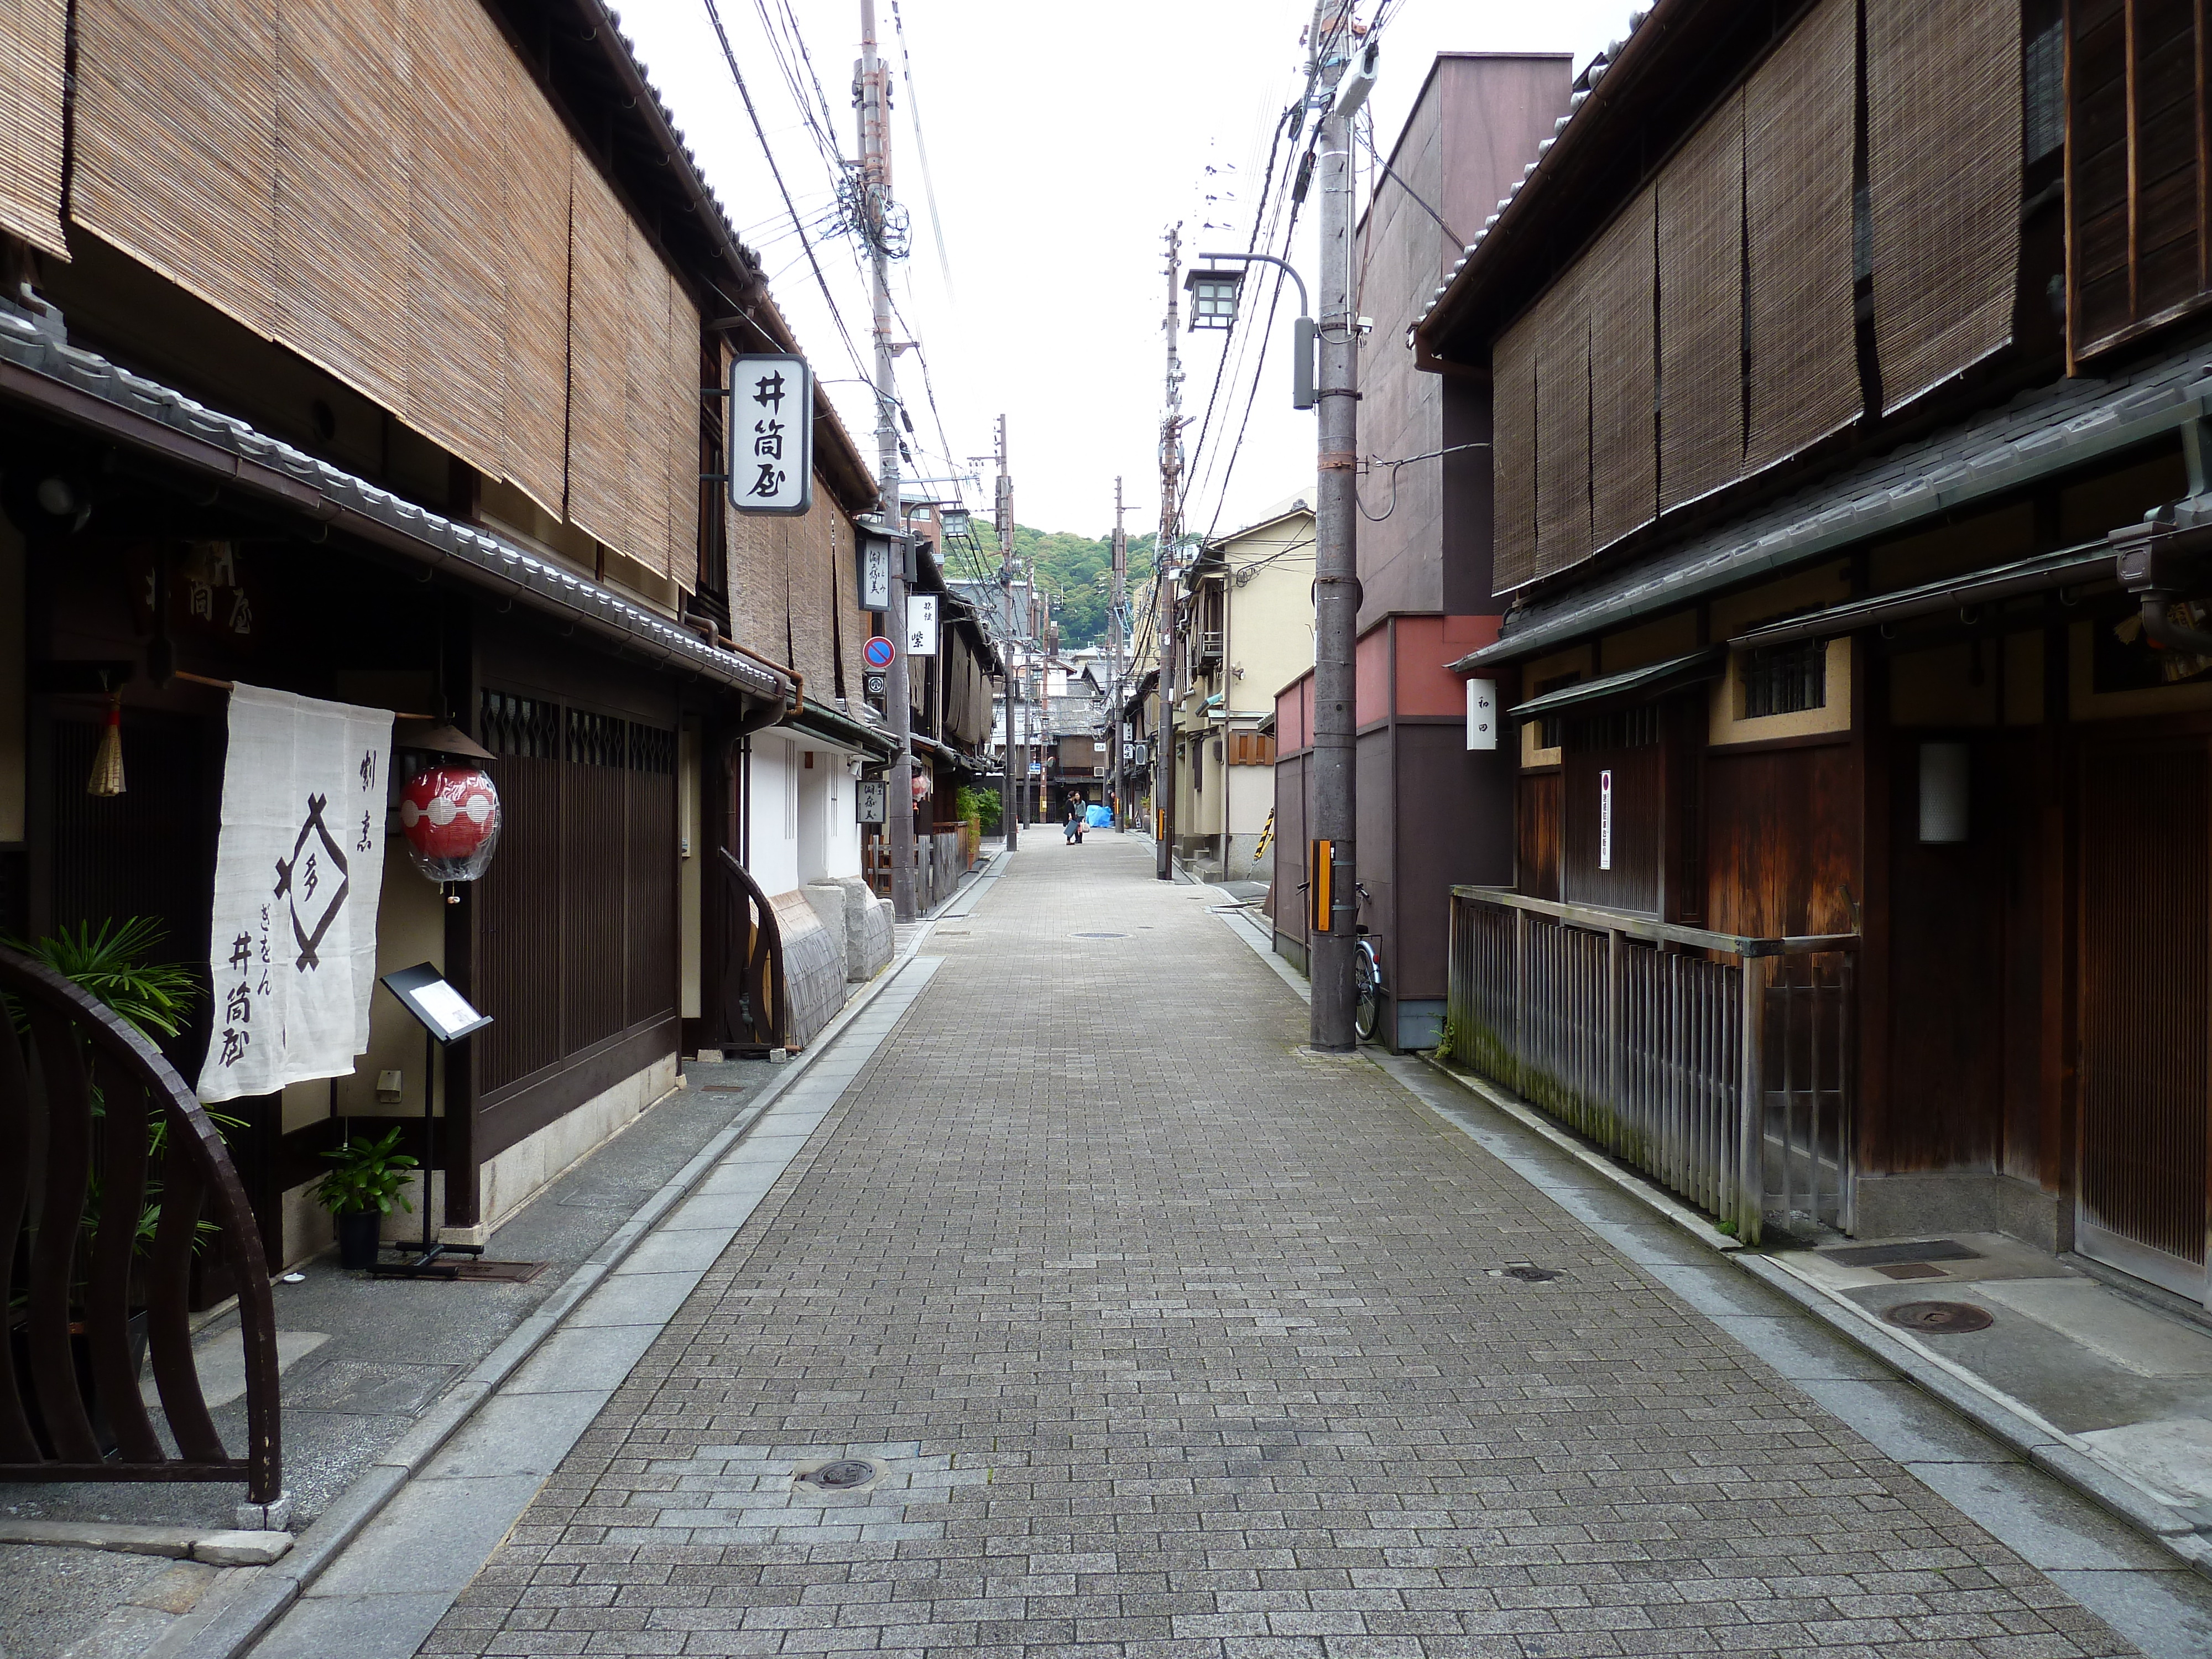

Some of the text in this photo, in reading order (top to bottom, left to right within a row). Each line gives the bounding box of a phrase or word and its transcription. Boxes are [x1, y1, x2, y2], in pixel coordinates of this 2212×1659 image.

[745, 369, 786, 497] 井筒屋
[1478, 696, 1489, 732] 和田
[356, 750, 377, 853] 割烹
[302, 852, 318, 903] 多
[219, 931, 252, 1068] 井筒屋
[259, 904, 273, 997] ぎをん
